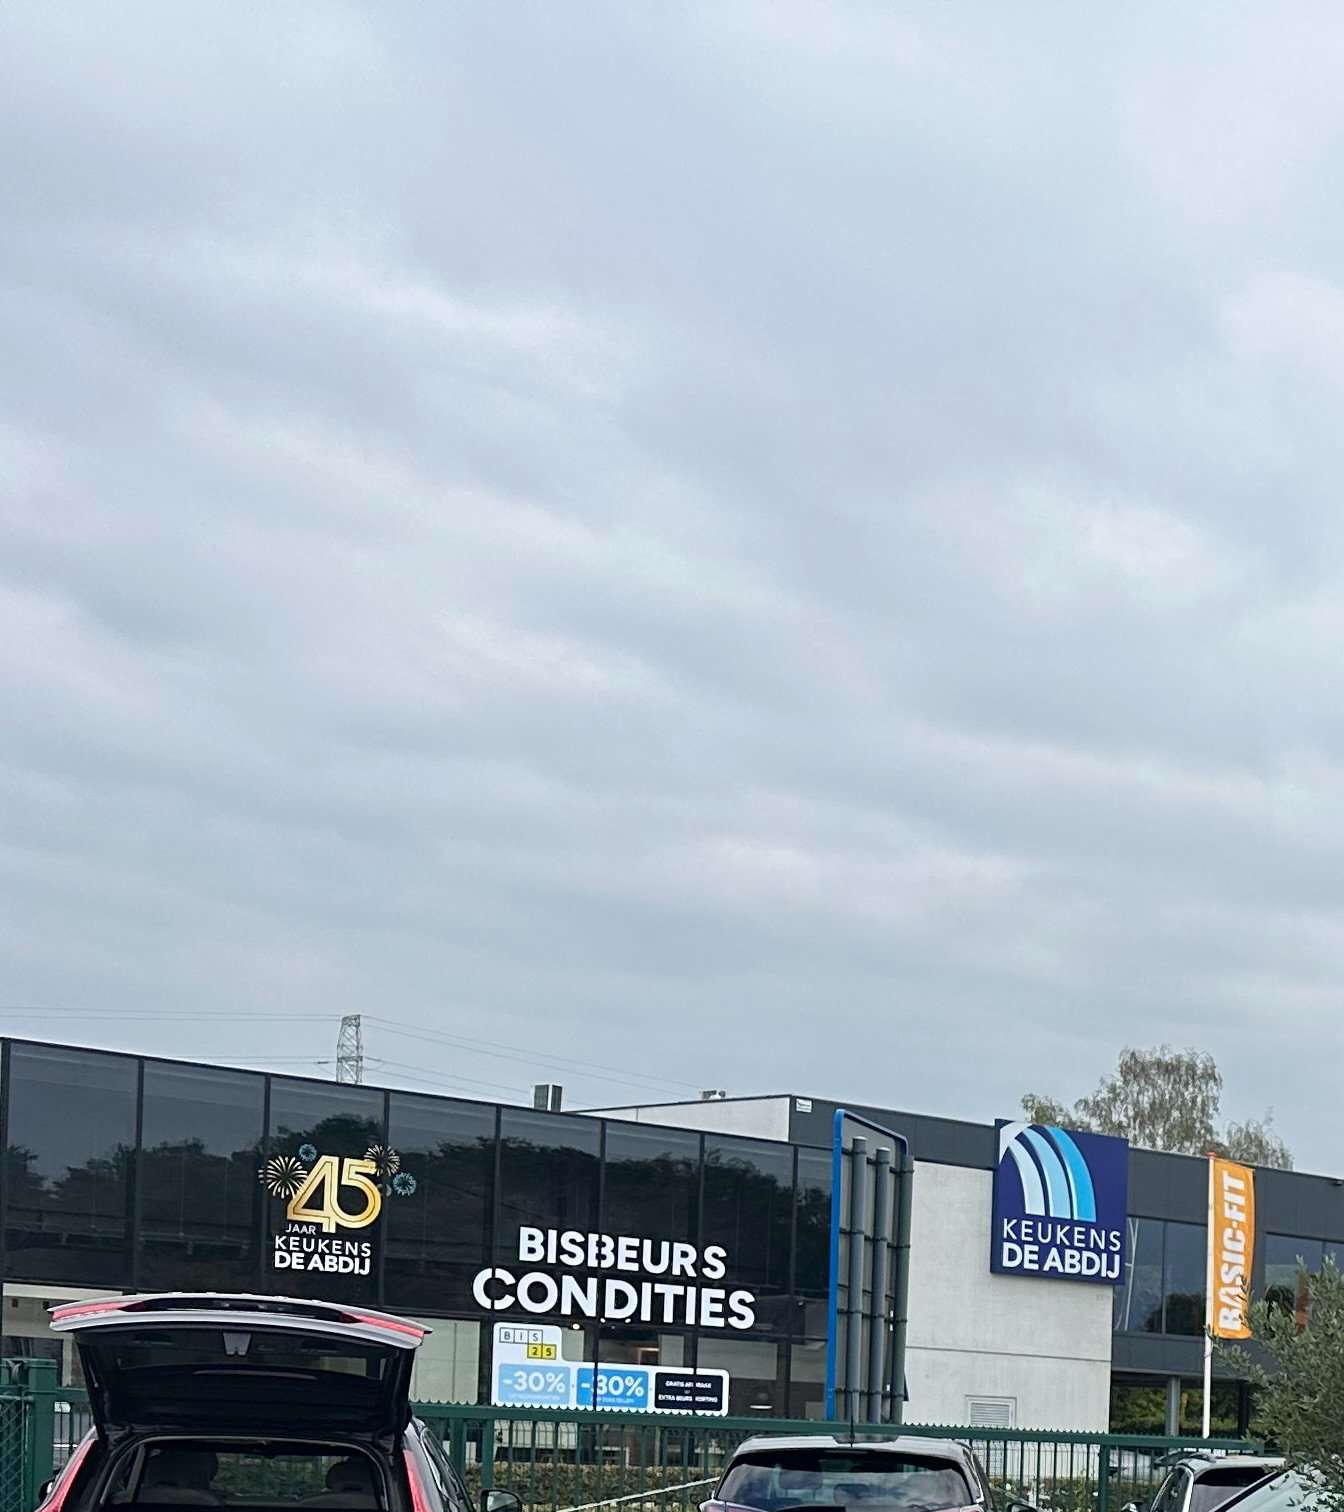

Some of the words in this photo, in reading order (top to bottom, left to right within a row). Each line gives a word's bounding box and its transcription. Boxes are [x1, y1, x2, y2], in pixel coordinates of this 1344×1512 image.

[287, 1155, 382, 1234] 45
[286, 1223, 316, 1235] JAAR
[1003, 1217, 1121, 1252] KEUKENS
[275, 1235, 371, 1257] KEUKENS
[519, 1226, 727, 1280] BISBEURS
[274, 1251, 305, 1270] DE
[307, 1253, 371, 1275] ABDIJ
[1002, 1241, 1039, 1271] DE
[1043, 1247, 1121, 1279] ABDIJ
[472, 1267, 755, 1330] CONDITIES
[532, 1346, 553, 1357] 25
[503, 1371, 565, 1393] -30%
[581, 1374, 645, 1397] -30%
